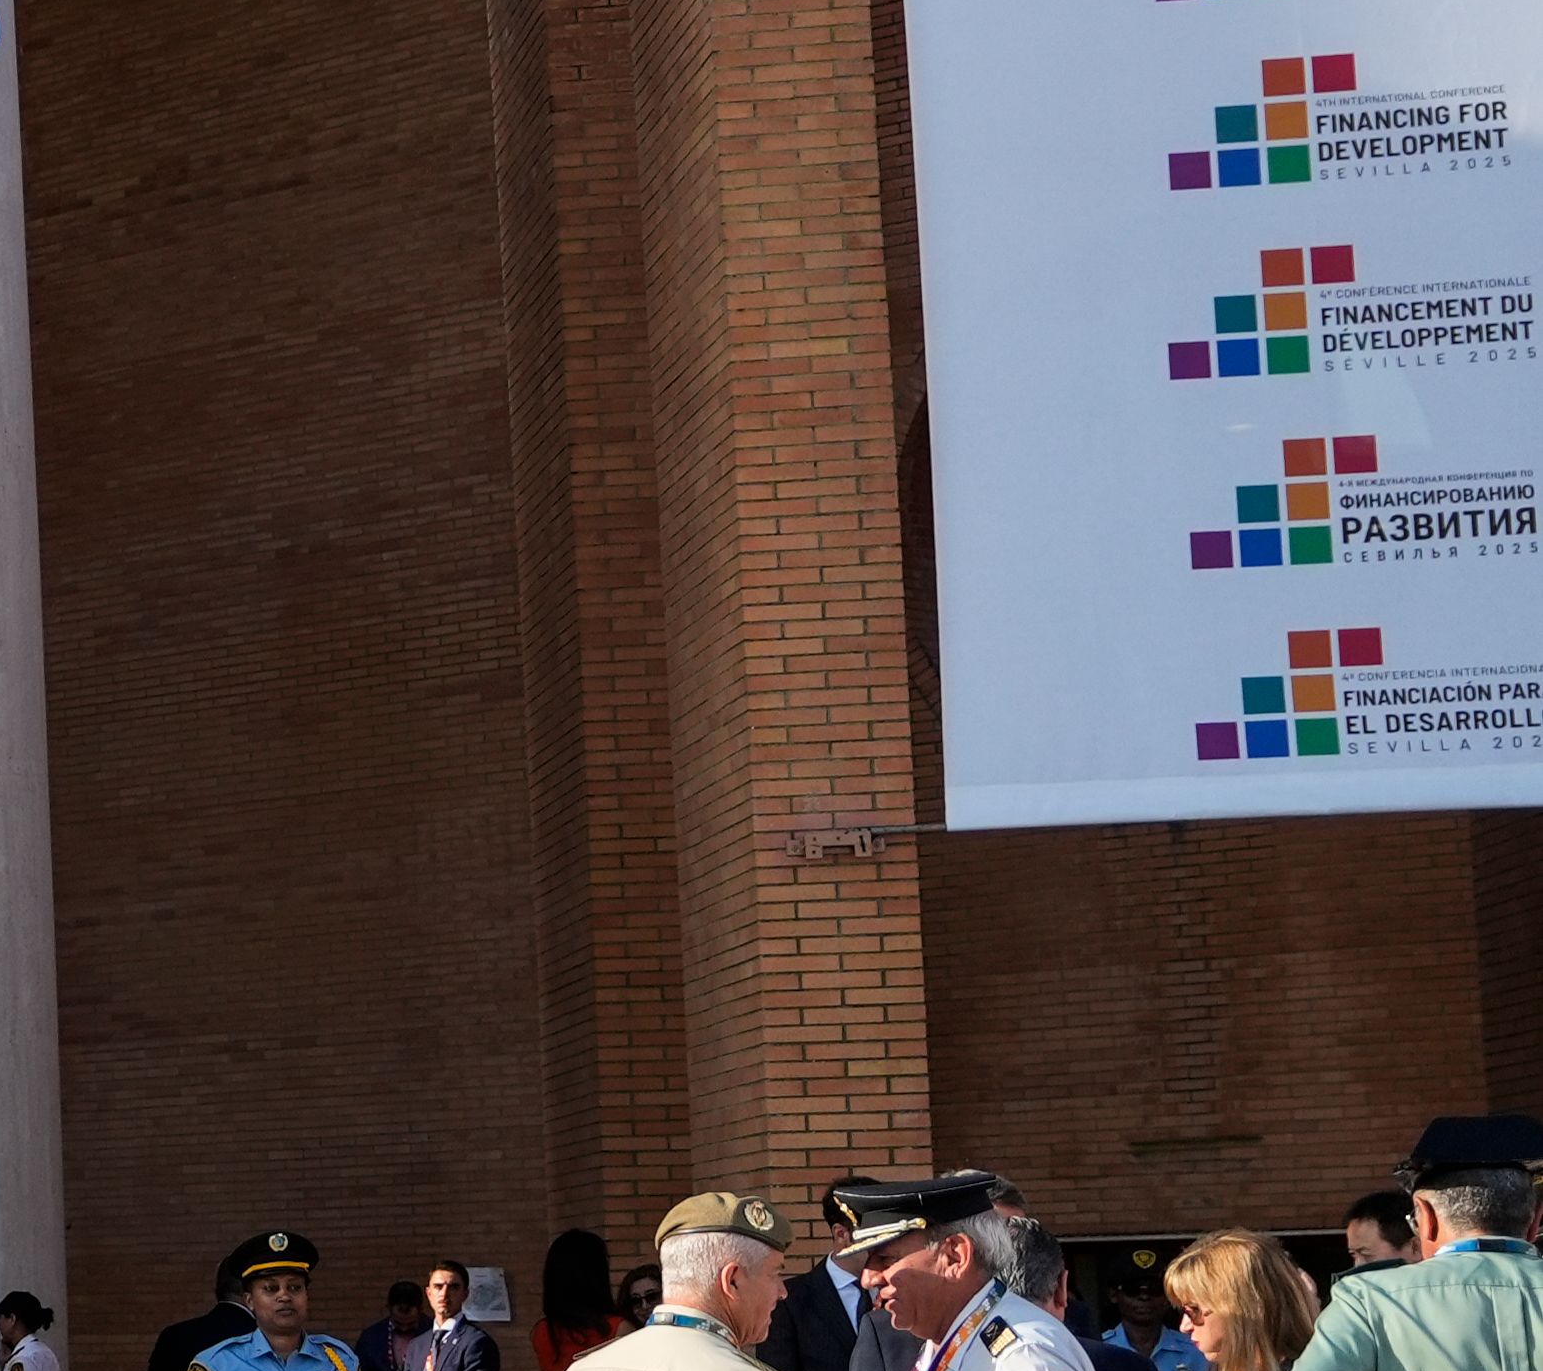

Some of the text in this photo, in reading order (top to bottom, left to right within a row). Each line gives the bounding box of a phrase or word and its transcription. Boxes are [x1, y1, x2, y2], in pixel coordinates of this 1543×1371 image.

[1315, 84, 1506, 107] 4TH INTERNATIONAL CONFERENCE
[1315, 100, 1508, 135] FINANCING FOR
[1318, 128, 1510, 162] DEVELOPMENT
[1319, 155, 1513, 181] SEVILLA 2025
[1421, 276, 1532, 293] INTERNATIONALE
[1320, 293, 1534, 326] FINANCEMENT DU
[1323, 320, 1535, 353] DÉVELOPPEMENT
[1468, 346, 1539, 364] 2025
[1519, 469, 1534, 478] ПО
[1339, 484, 1535, 510] ФИНАНСИРОВАНИЮ
[1341, 507, 1538, 544] РАЗВИТИЯ
[1343, 541, 1539, 563] СЕВИЛЬЯ 2025
[1357, 669, 1447, 682] CONFERENCIA
[1450, 664, 1543, 678] INTERNACIONA
[1343, 682, 1543, 707] FINANCIACIÓN PAR
[1346, 707, 1543, 735] EL DESARROLL
[1348, 735, 1543, 755] SEVILLA 202
